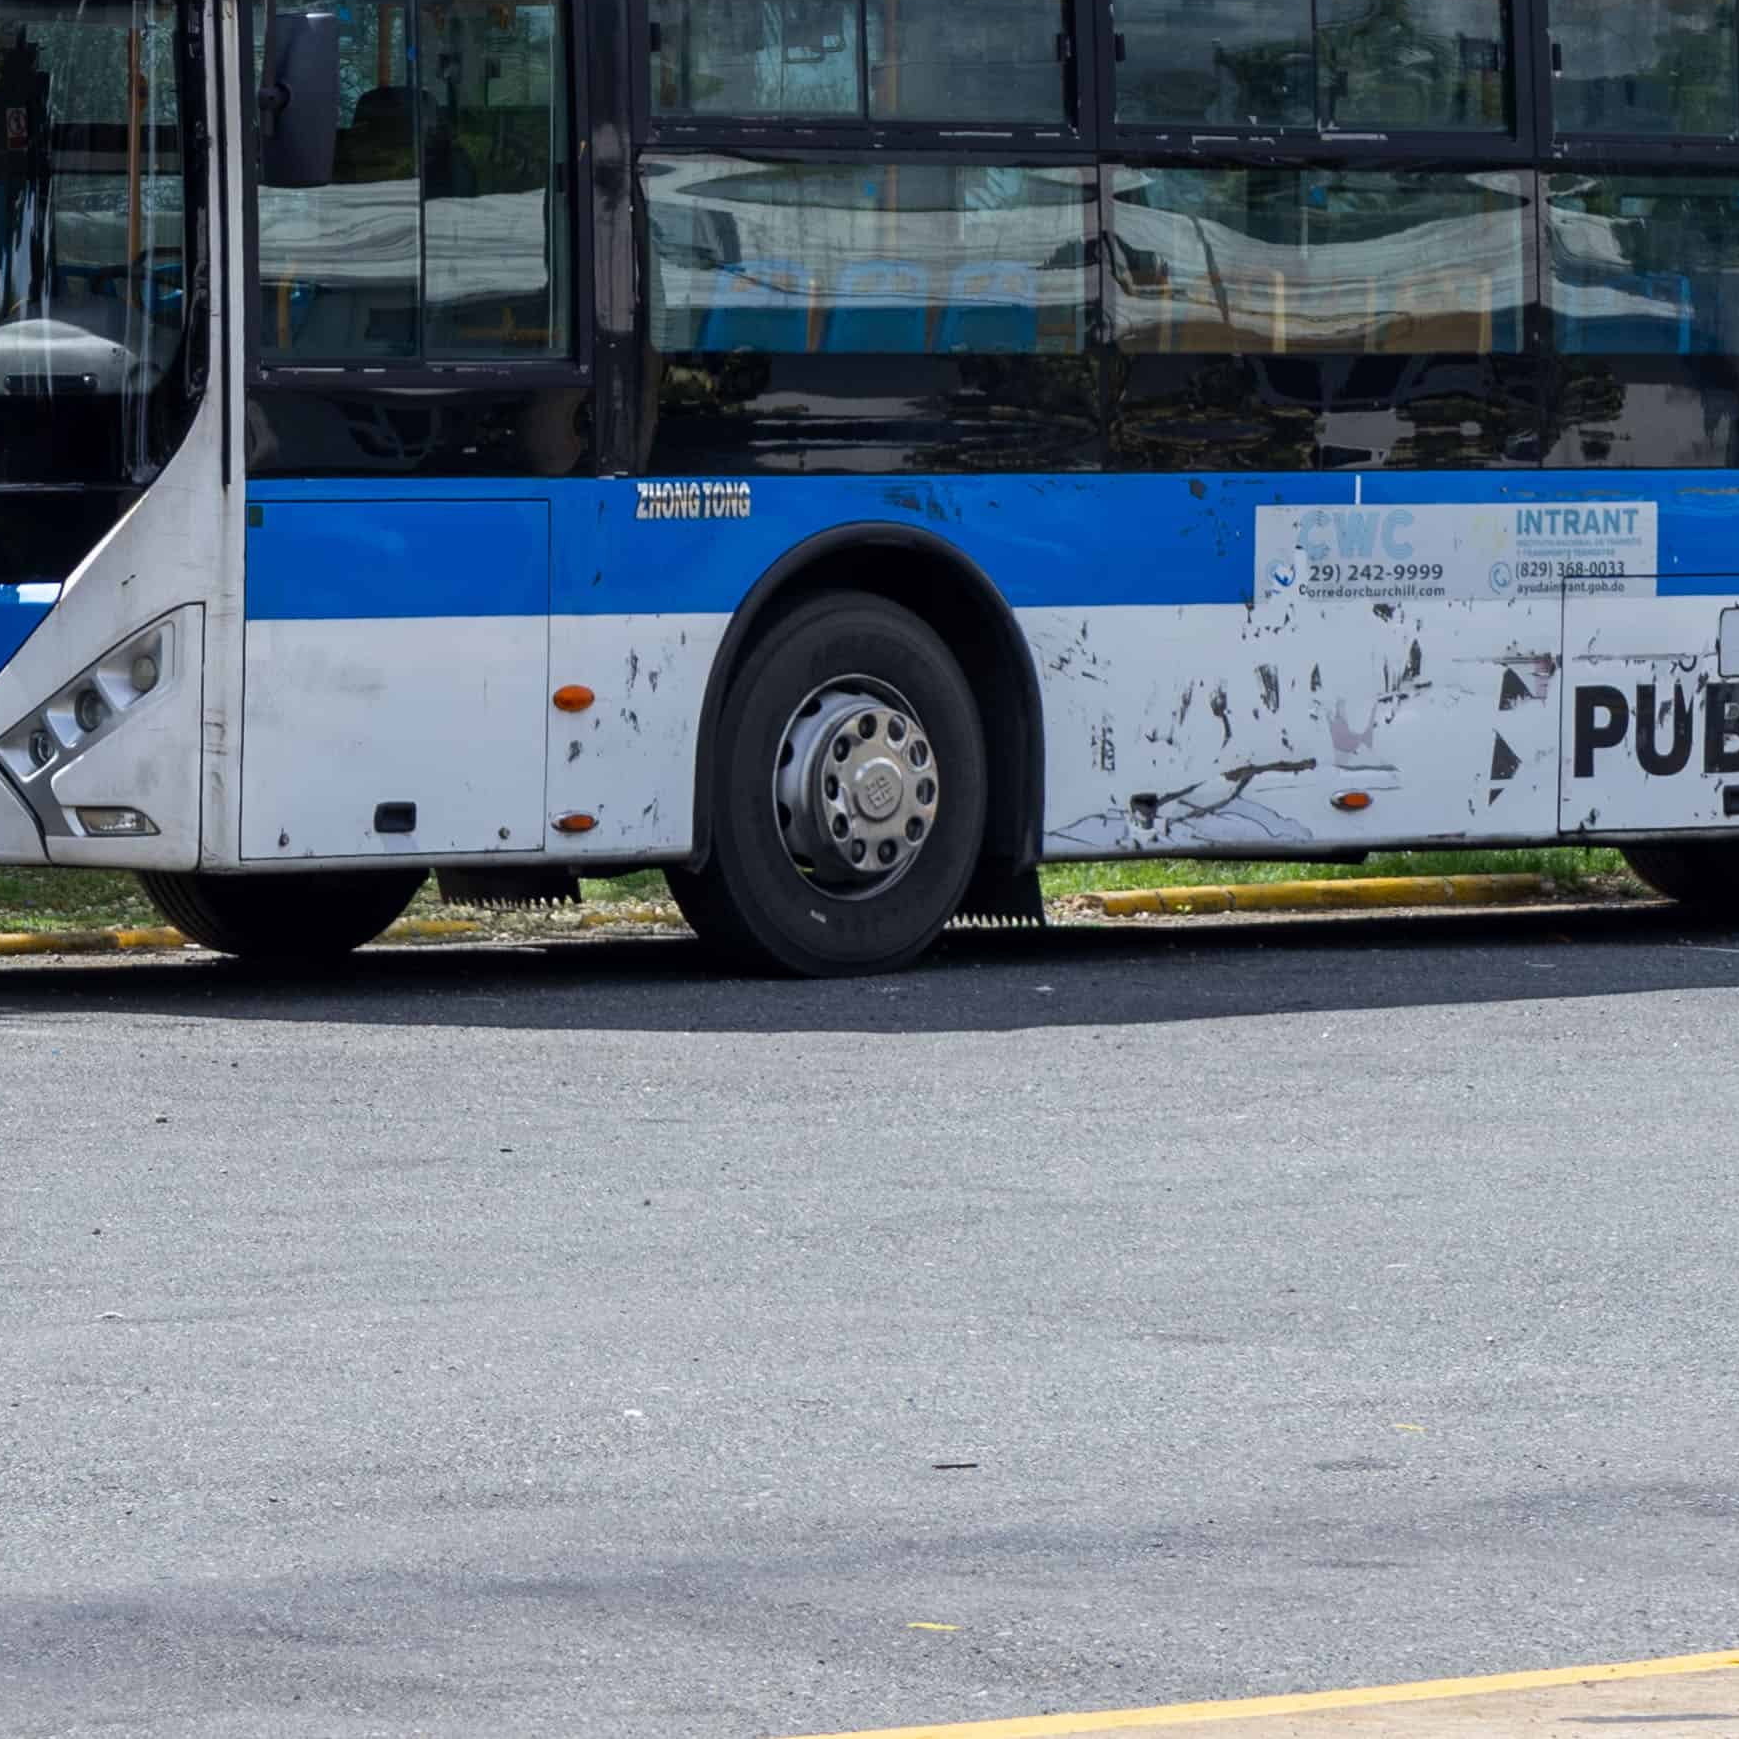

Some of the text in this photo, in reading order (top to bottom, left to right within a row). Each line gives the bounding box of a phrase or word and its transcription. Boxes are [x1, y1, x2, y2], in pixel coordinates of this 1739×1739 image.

[636, 481, 750, 519] ZHONG TONG
[1299, 509, 1414, 561] CWC
[1516, 507, 1639, 535] INTRANT
[1348, 563, 1443, 582] 242-9999
[1516, 561, 1625, 579] (829) 368-0033
